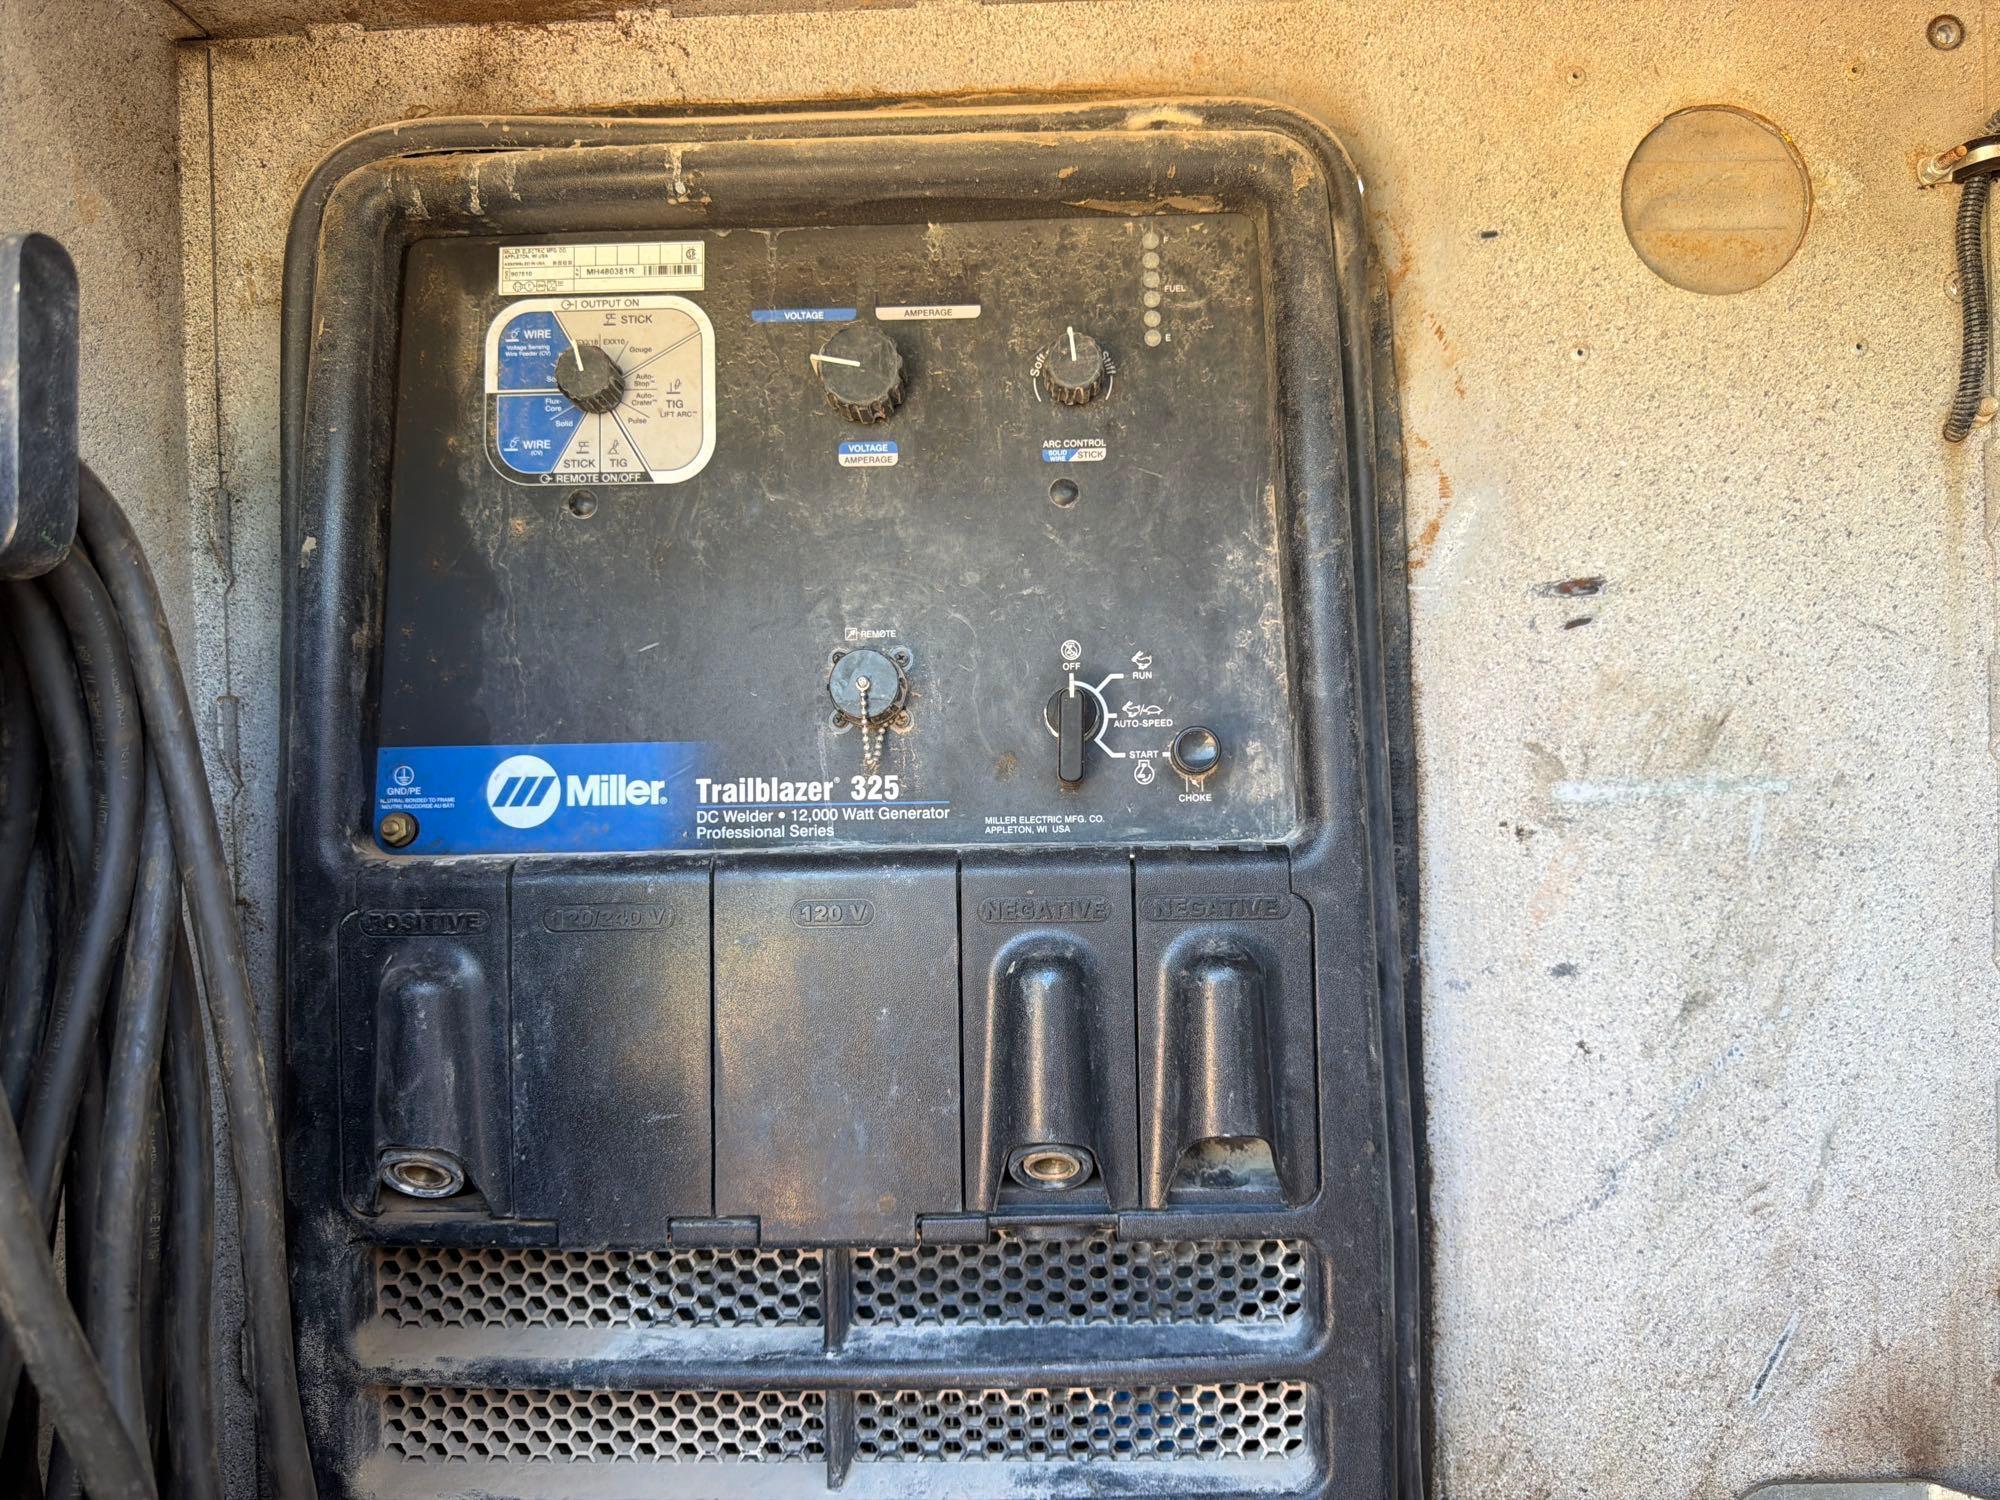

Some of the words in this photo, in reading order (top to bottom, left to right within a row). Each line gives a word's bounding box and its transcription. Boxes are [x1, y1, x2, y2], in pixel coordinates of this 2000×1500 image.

[586, 267, 635, 276] MH480381R
[1164, 285, 1186, 293] FUEL
[580, 300, 623, 309] OUTPUT
[624, 299, 640, 308] ON
[784, 311, 824, 320] VOLTAGE
[904, 308, 953, 317] AMPERAGE
[620, 314, 653, 325] STICK
[524, 330, 552, 339] WIRE
[1165, 334, 1172, 342] E
[630, 346, 653, 355] Gouge
[545, 398, 562, 406] Flux-
[666, 400, 684, 409] TIG
[555, 420, 574, 428] Solid
[523, 440, 552, 450] WIRE
[1042, 440, 1062, 448] ARC
[1063, 439, 1106, 448] CONTROL
[848, 444, 888, 453] VOLTAGE
[1078, 450, 1103, 458] STICK
[563, 458, 596, 468] STICK
[610, 458, 628, 468] TIG
[844, 455, 894, 464] AMPERAGE
[556, 474, 599, 483] REMOTE
[602, 473, 642, 483] ON/OFF
[860, 630, 896, 638] REMOTE
[1062, 662, 1081, 671] OFF
[1132, 672, 1153, 680] RUN
[1114, 719, 1174, 728] AUTO-SPEED
[1129, 750, 1159, 759] START
[386, 787, 422, 796] GND/PE
[567, 774, 665, 806] Miller
[696, 775, 834, 804] Trailblazer
[850, 774, 900, 801] 325
[1178, 794, 1212, 802] CHOKE
[696, 810, 720, 824] DC
[724, 809, 773, 824] Welder
[790, 808, 838, 824] 12,000
[843, 808, 874, 820] Watt
[878, 806, 950, 820] Generator
[984, 816, 1017, 824] MILLER
[1018, 815, 1062, 824] ELECTRIC
[1064, 815, 1087, 823] MFG.
[1088, 814, 1105, 823] CO.
[696, 825, 785, 840] Professional
[789, 824, 834, 838] Series
[984, 826, 1034, 834] APPLETON,
[1052, 825, 1071, 833] USA
[986, 900, 1106, 921] NEGATIVE
[1154, 898, 1281, 918] NEGATIVE
[801, 904, 842, 922] 120
[850, 904, 867, 922] V
[368, 912, 481, 932] POSITIVE
[549, 908, 642, 928] 120/240
[649, 908, 666, 926] V
